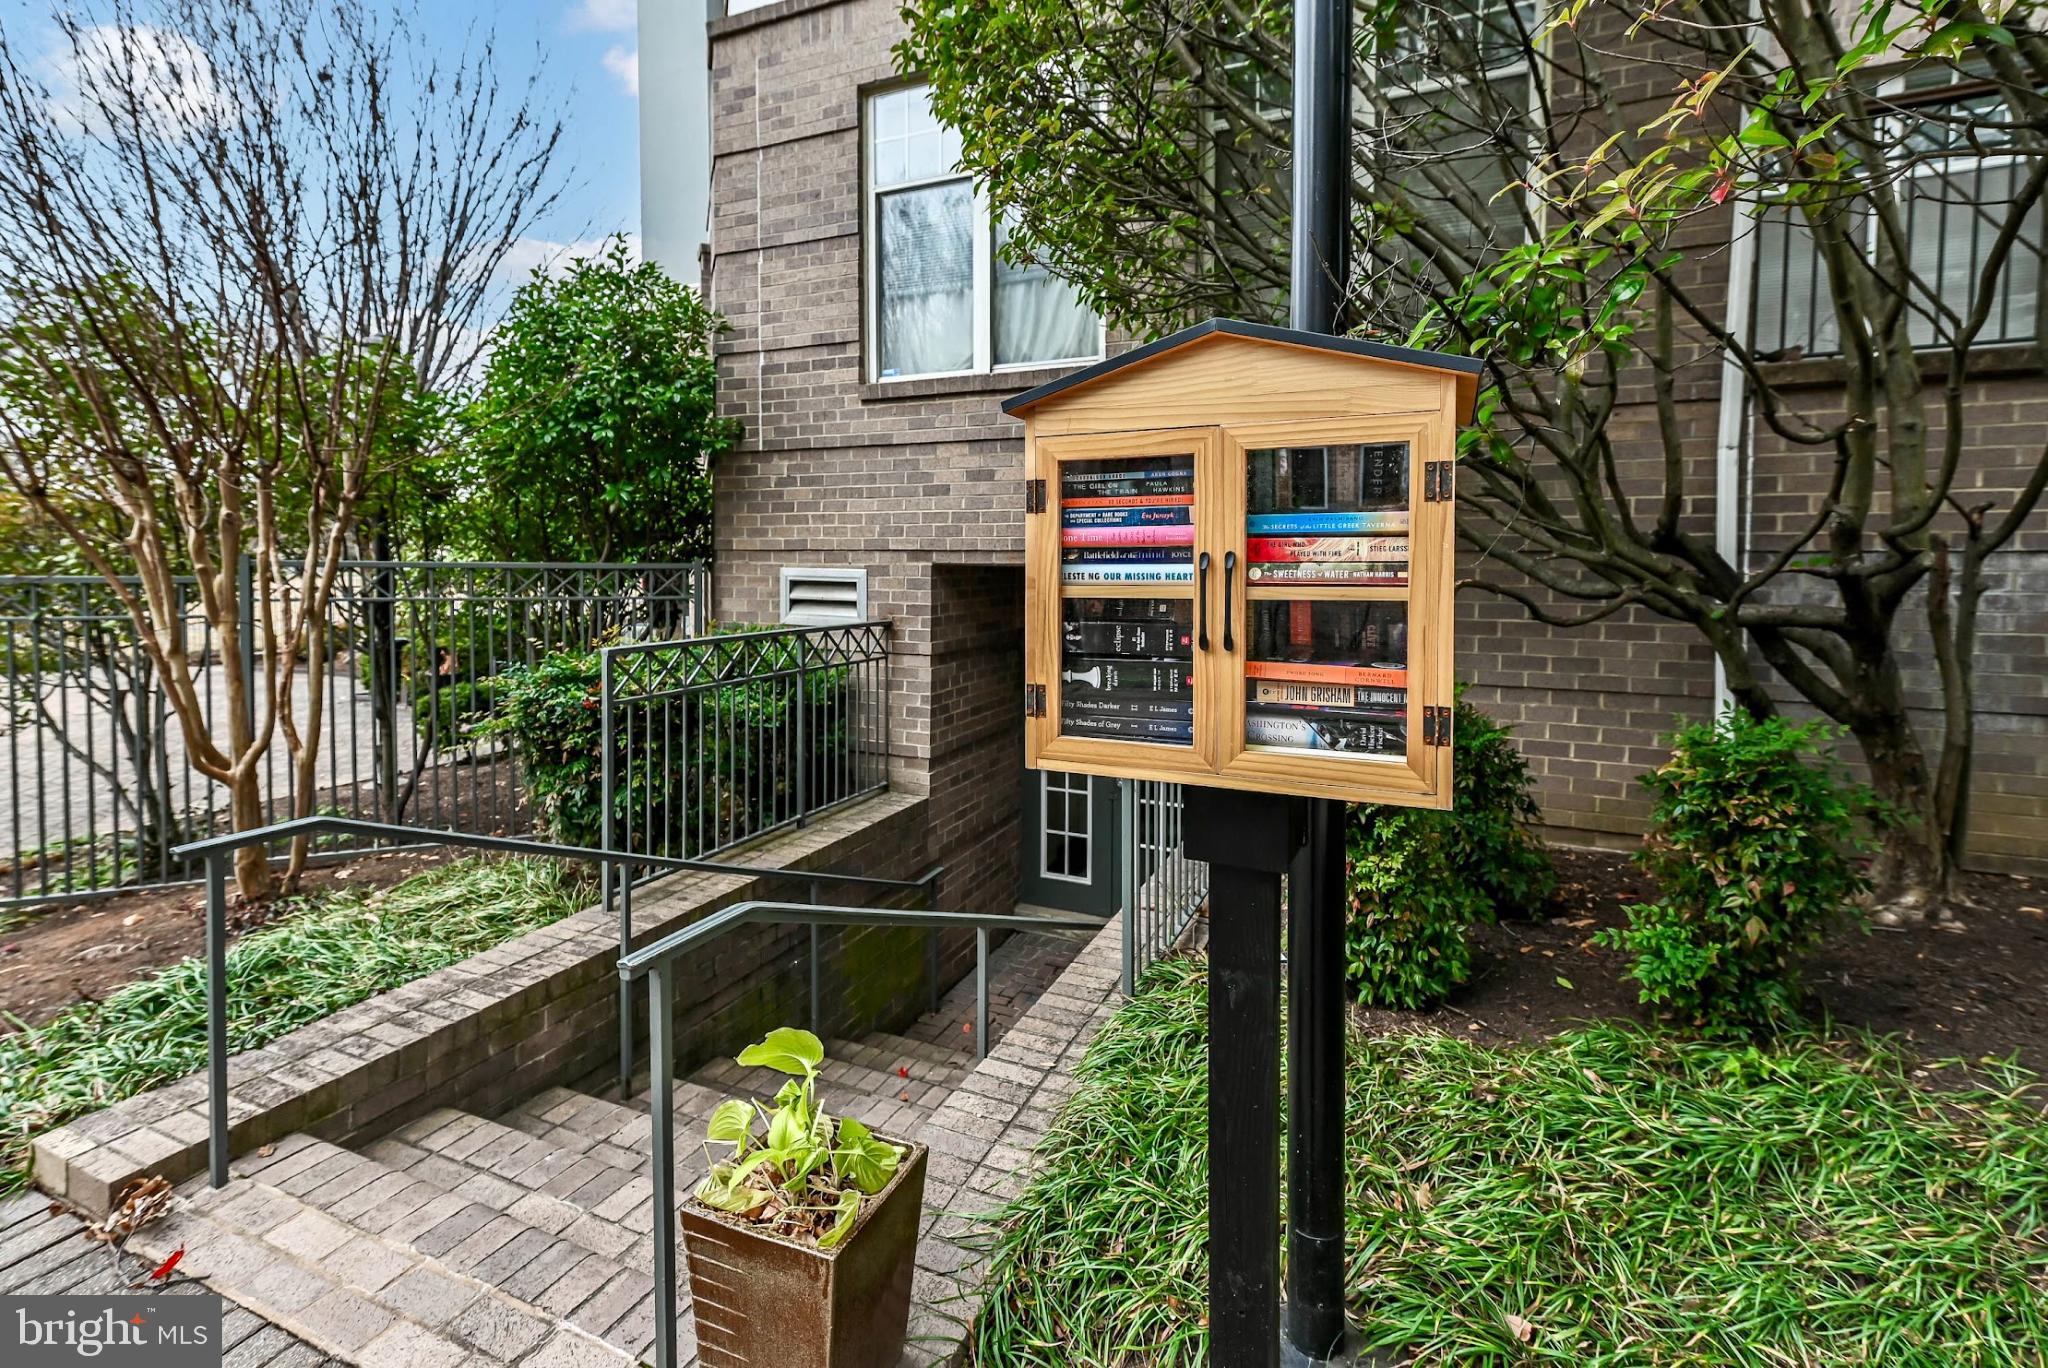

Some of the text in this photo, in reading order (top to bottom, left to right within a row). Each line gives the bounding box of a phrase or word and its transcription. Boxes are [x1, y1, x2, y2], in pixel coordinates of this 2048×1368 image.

[1373, 449, 1383, 497] ENDER
[1088, 572, 1100, 580] NG
[1104, 572, 1121, 580] OUR
[1125, 572, 1162, 580] MISSING
[1165, 572, 1193, 580] HEART
[1273, 570, 1316, 579] SWEETNESS
[1325, 570, 1349, 579] WATER
[1113, 625, 1124, 652] eclipse
[1105, 665, 1113, 691] breaking
[1285, 685, 1308, 701] JOHN
[1310, 686, 1351, 703] GRISHAM
[1358, 691, 1369, 702] THE
[1370, 692, 1402, 704] INNOCENT
[1076, 701, 1097, 709] Shades
[1099, 701, 1120, 709] Darker
[1076, 718, 1097, 726] Shades
[1106, 721, 1121, 729] Grey
[1248, 720, 1306, 730] ASHINGTON'S
